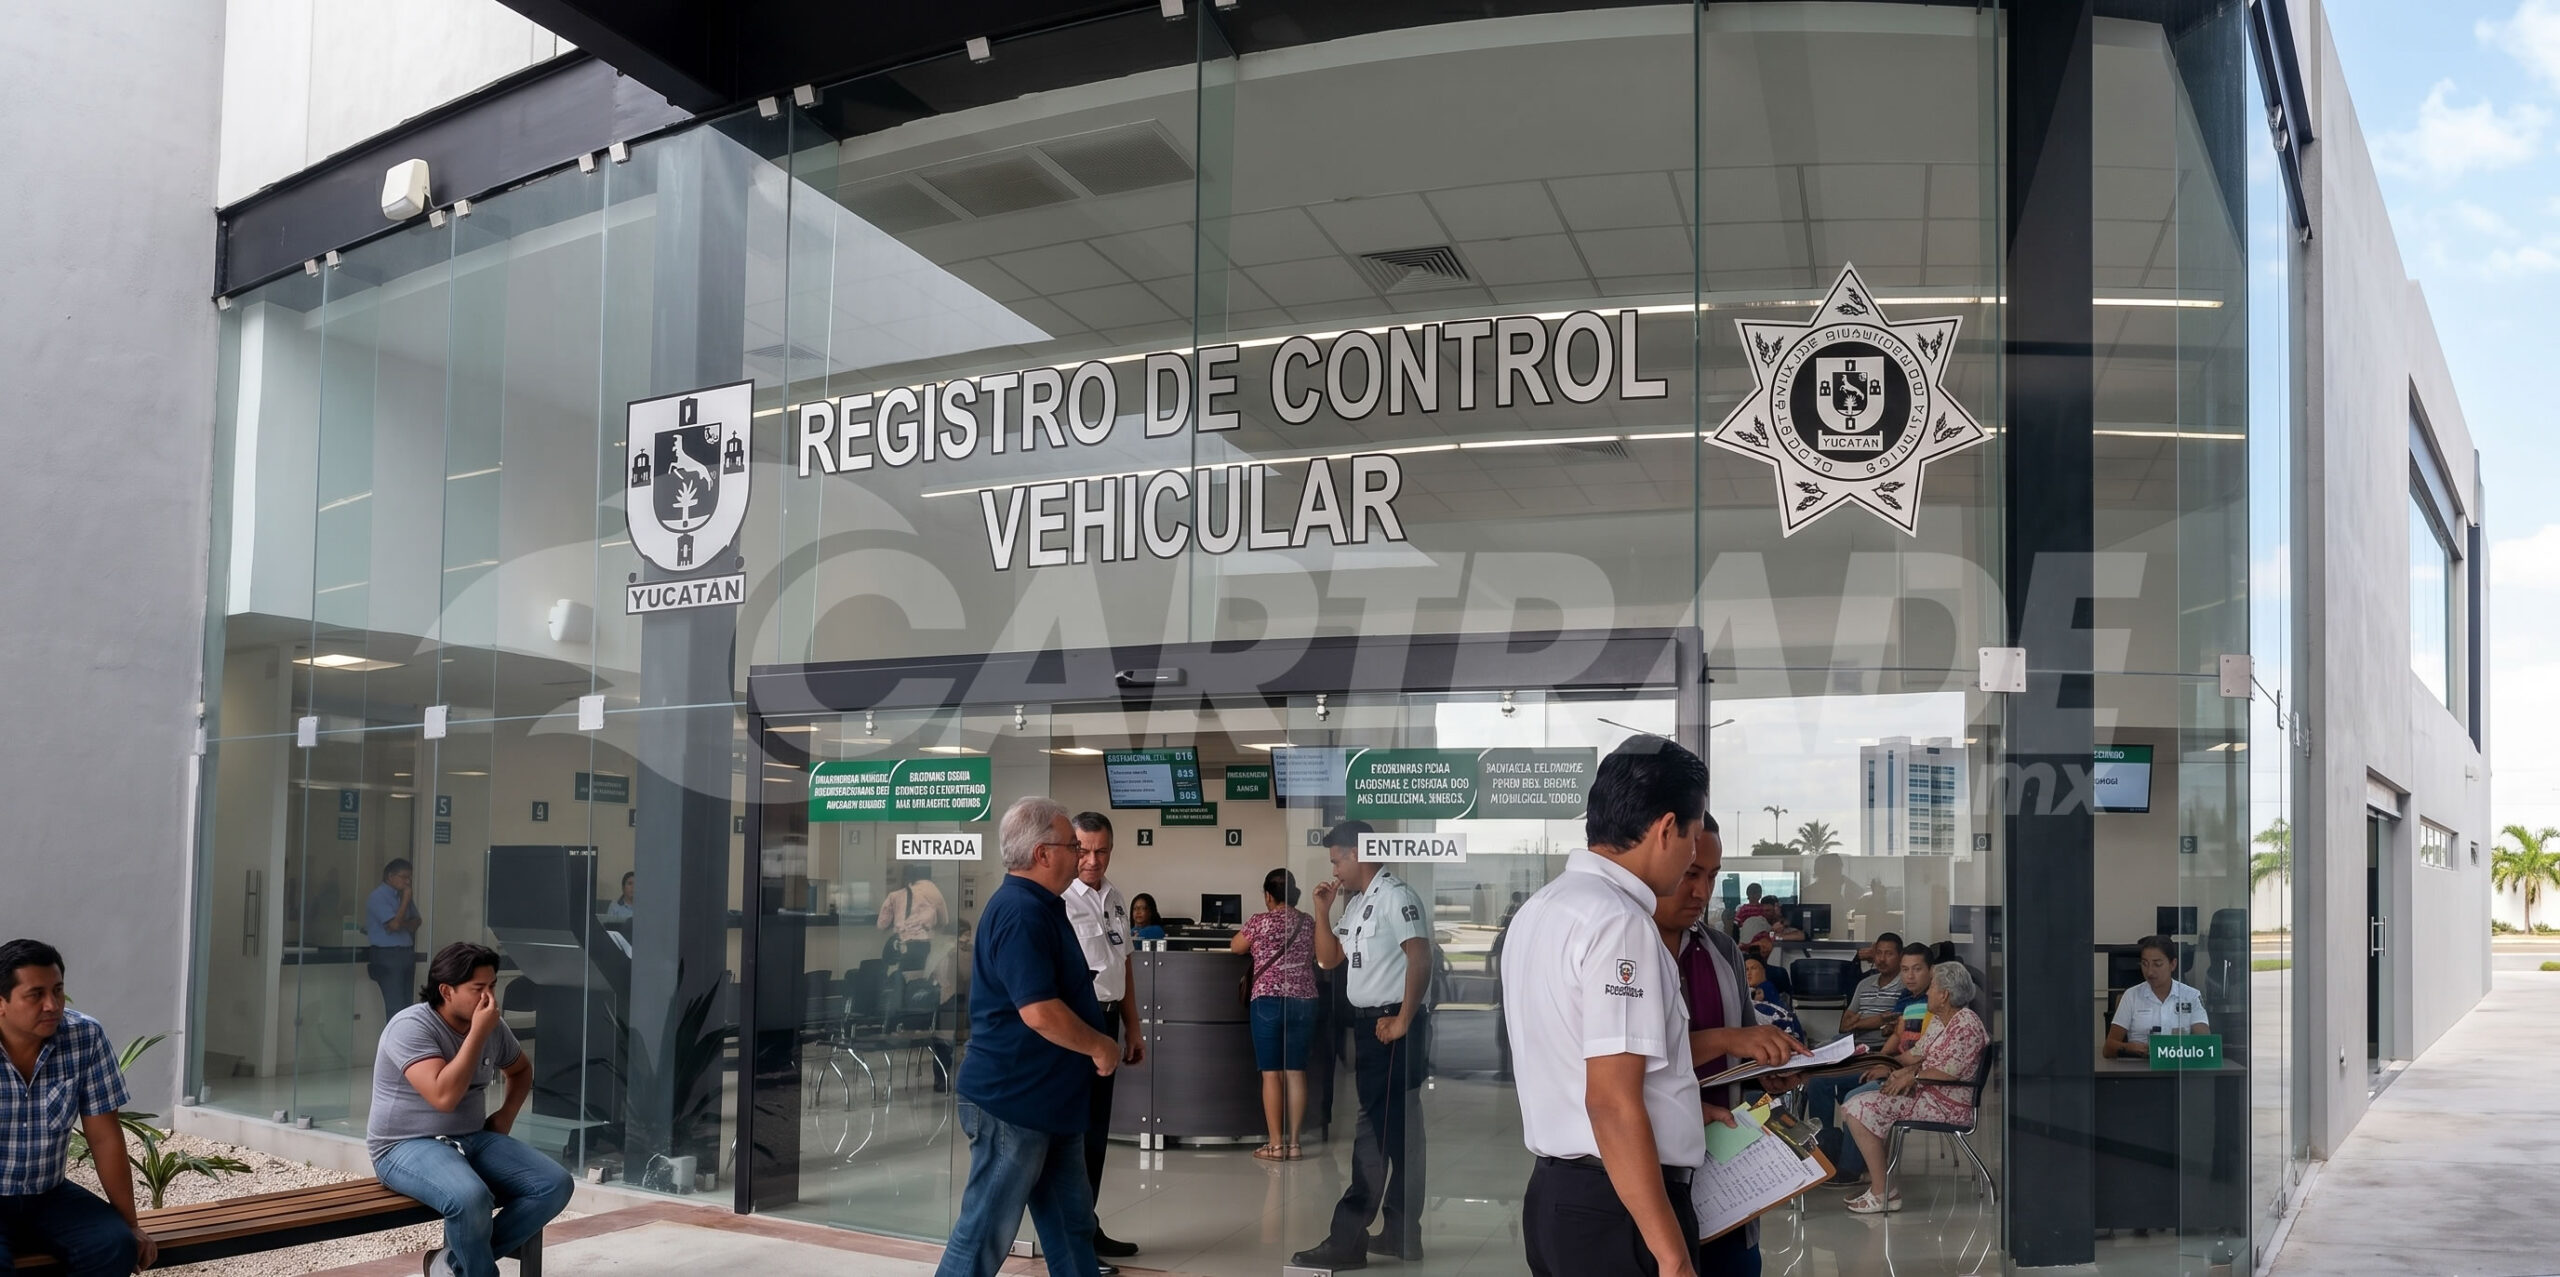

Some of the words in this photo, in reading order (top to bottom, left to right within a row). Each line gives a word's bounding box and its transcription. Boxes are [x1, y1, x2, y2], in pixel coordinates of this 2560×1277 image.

[798, 360, 1118, 479] REGISTRO
[1144, 343, 1240, 438] DE
[1270, 308, 1669, 426] CONTROL
[980, 453, 1407, 571] VEHICULAR
[631, 577, 741, 611] YUCATÁN
[344, 792, 354, 810] 3
[439, 798, 448, 814] 5
[902, 839, 976, 856] ENTRADA
[1366, 839, 1458, 857] ENTRADA
[2157, 1045, 2205, 1059] Módulo
[2208, 1046, 2215, 1058] 1
